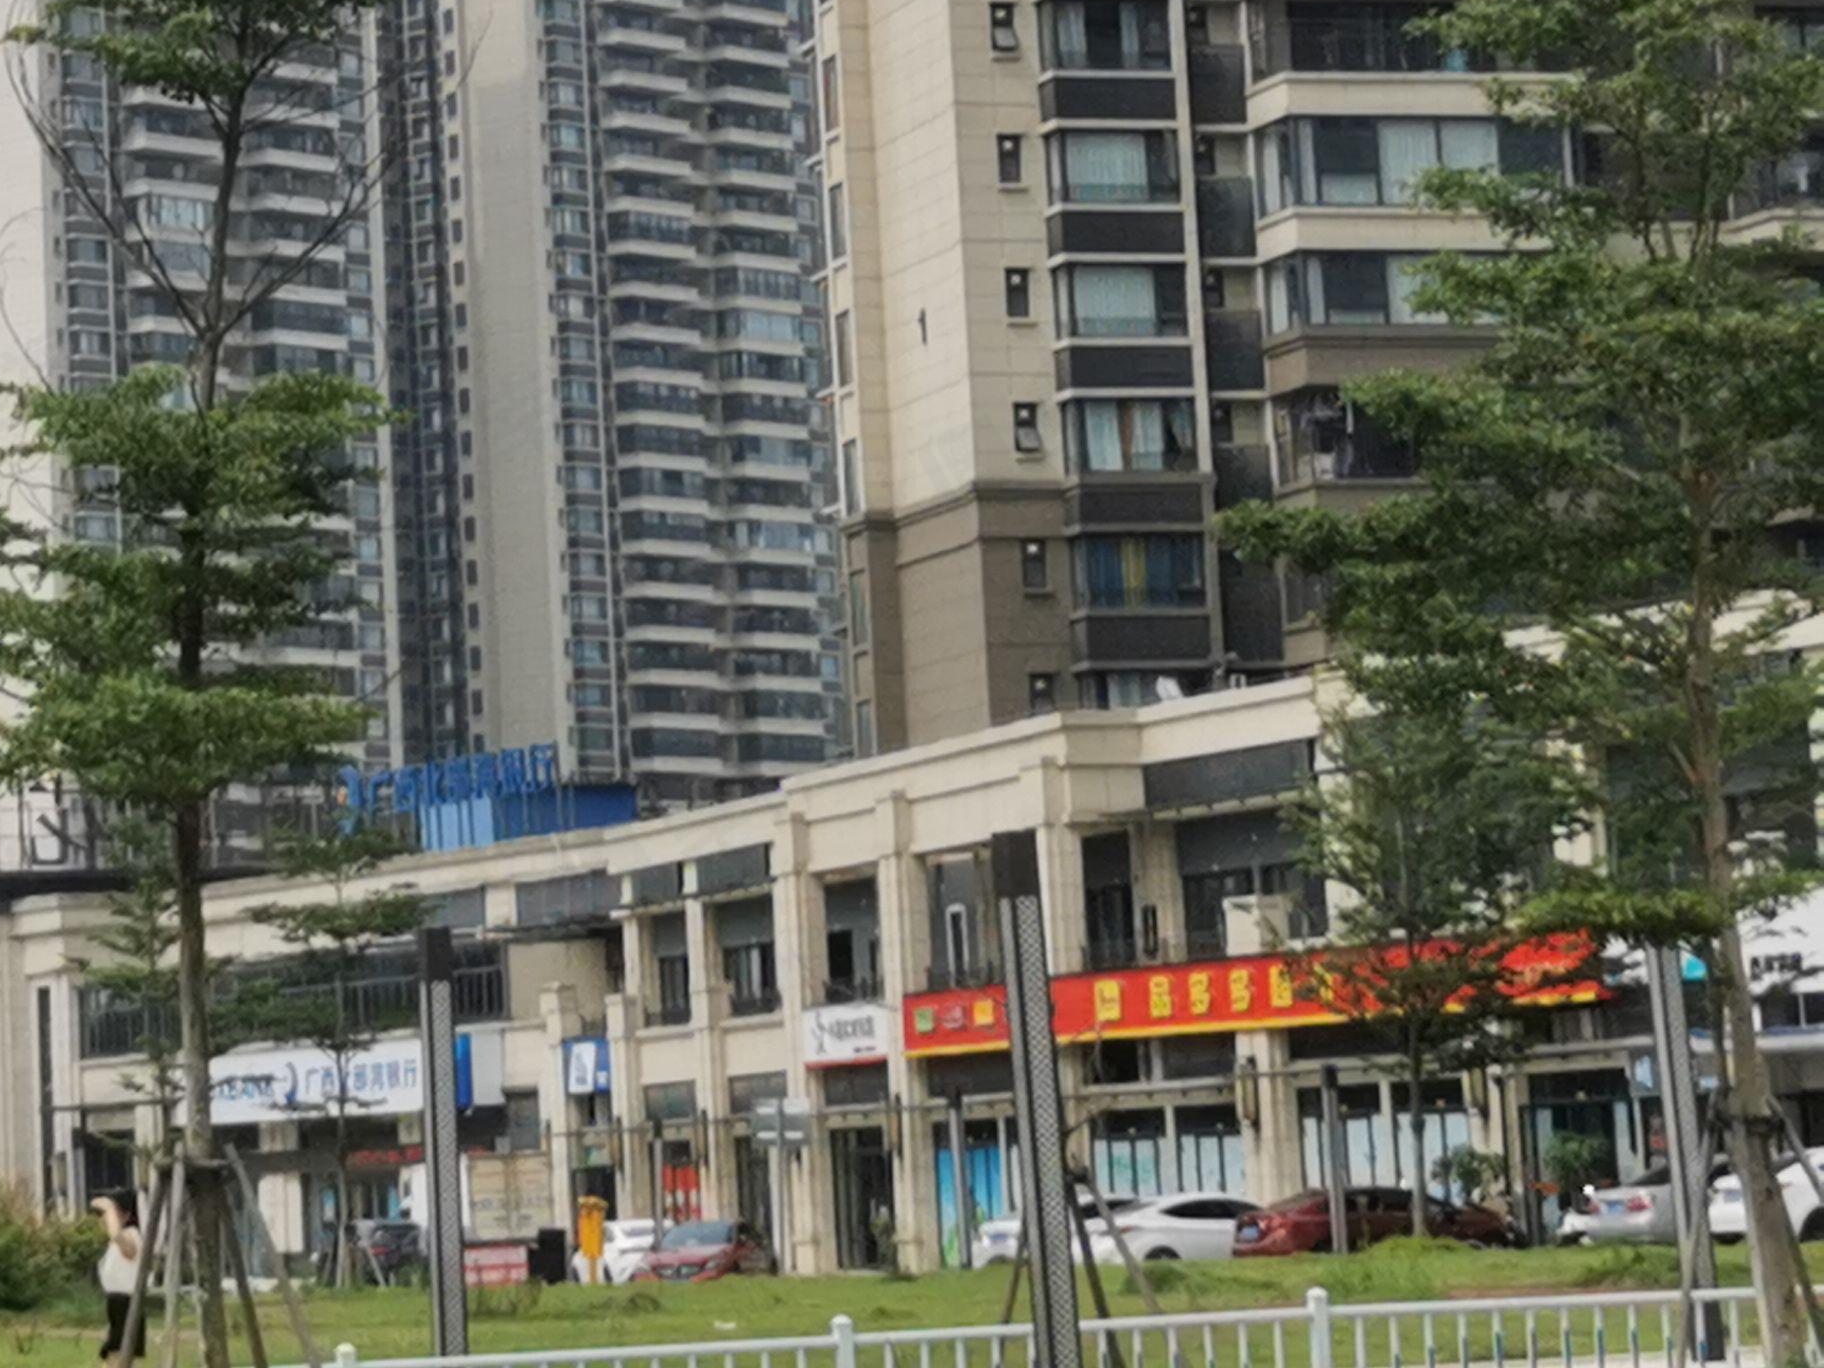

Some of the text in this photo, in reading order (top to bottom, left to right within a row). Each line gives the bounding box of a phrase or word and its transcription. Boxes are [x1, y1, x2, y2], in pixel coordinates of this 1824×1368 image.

[305, 1058, 417, 1097] 广西部湾银行
